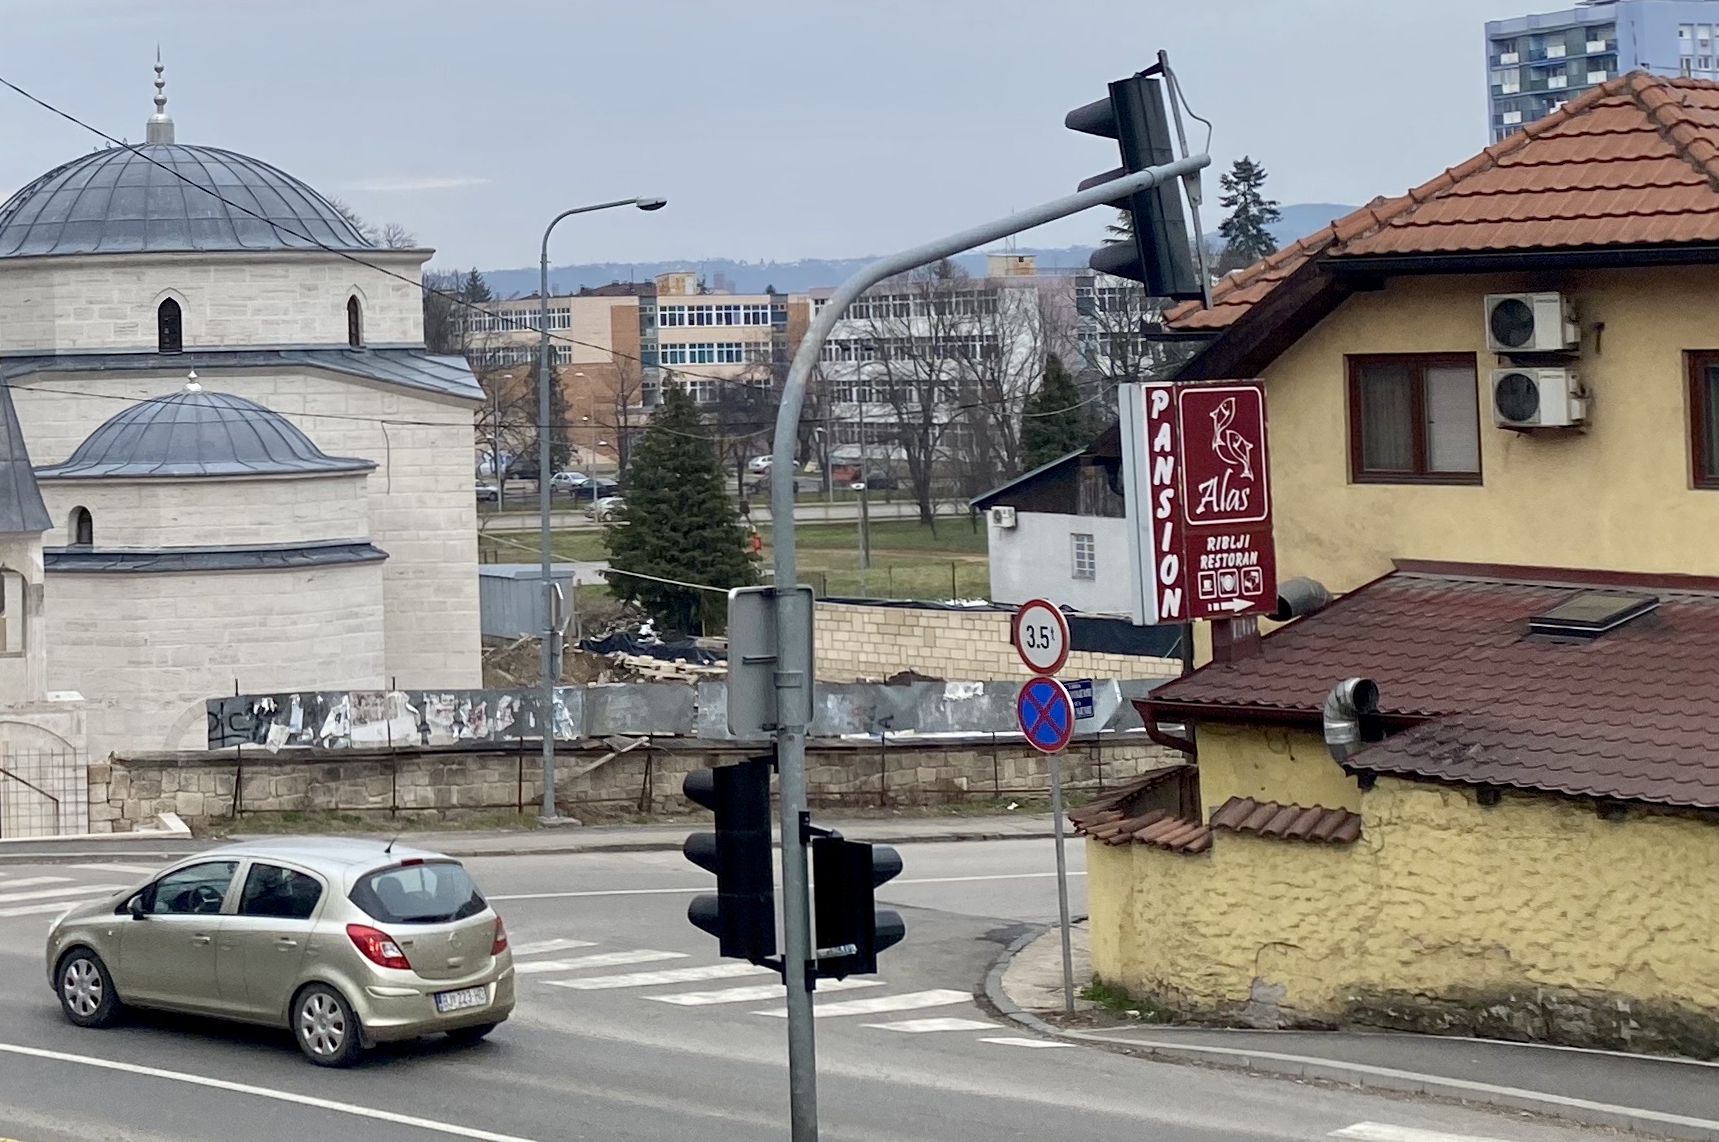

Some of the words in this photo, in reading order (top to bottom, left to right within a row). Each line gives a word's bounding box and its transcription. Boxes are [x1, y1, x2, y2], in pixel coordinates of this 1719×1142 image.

[1150, 389, 1182, 618] PANSION
[1195, 468, 1251, 515] Alas
[1206, 534, 1251, 551] RIBLJI
[1200, 551, 1259, 570] RESTORAN
